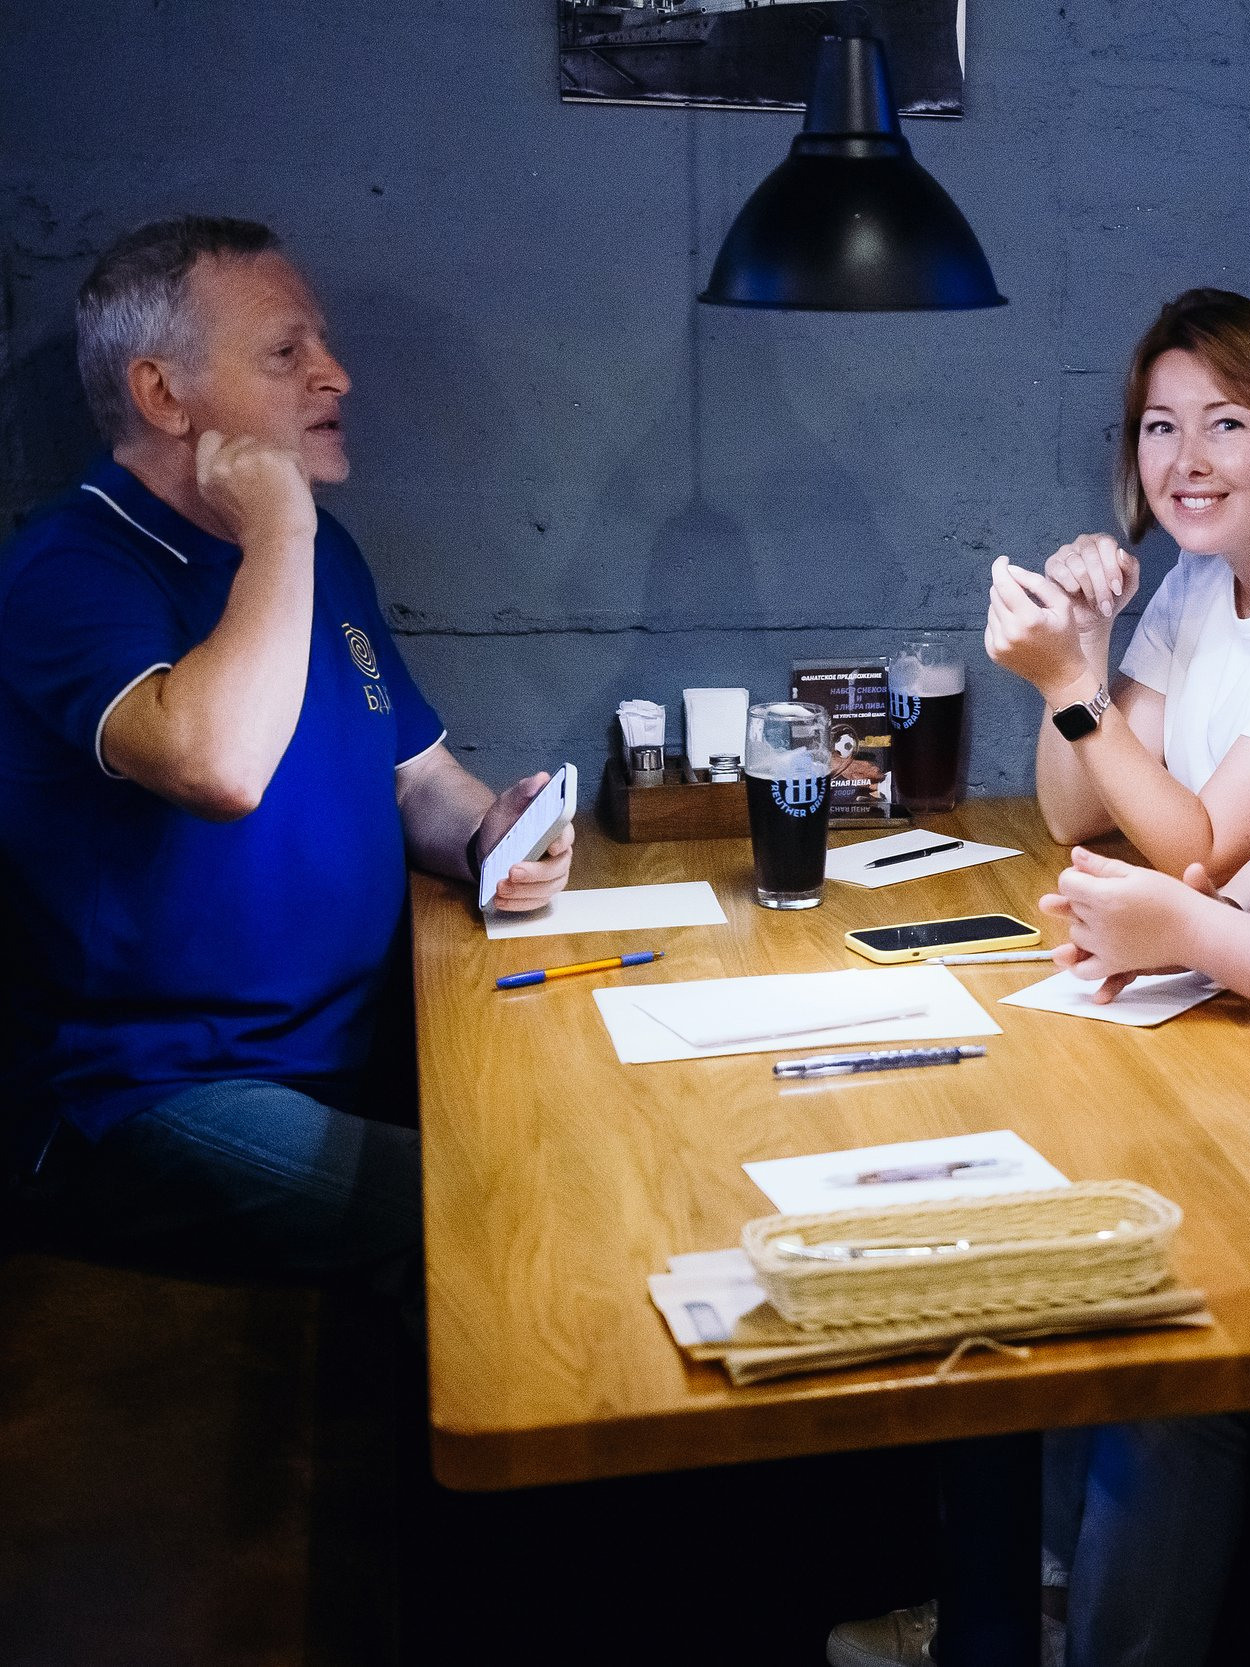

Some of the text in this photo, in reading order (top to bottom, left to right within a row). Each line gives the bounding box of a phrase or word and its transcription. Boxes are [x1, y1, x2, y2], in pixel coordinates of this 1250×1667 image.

[801, 672, 882, 682] ФАНАТСКОЕ ПРЕДЛОЖЕНИЕ
[830, 686, 856, 695] НАБОР
[865, 702, 886, 711] ПИВА
[830, 778, 872, 788] СНАЯ ЦЕНА
